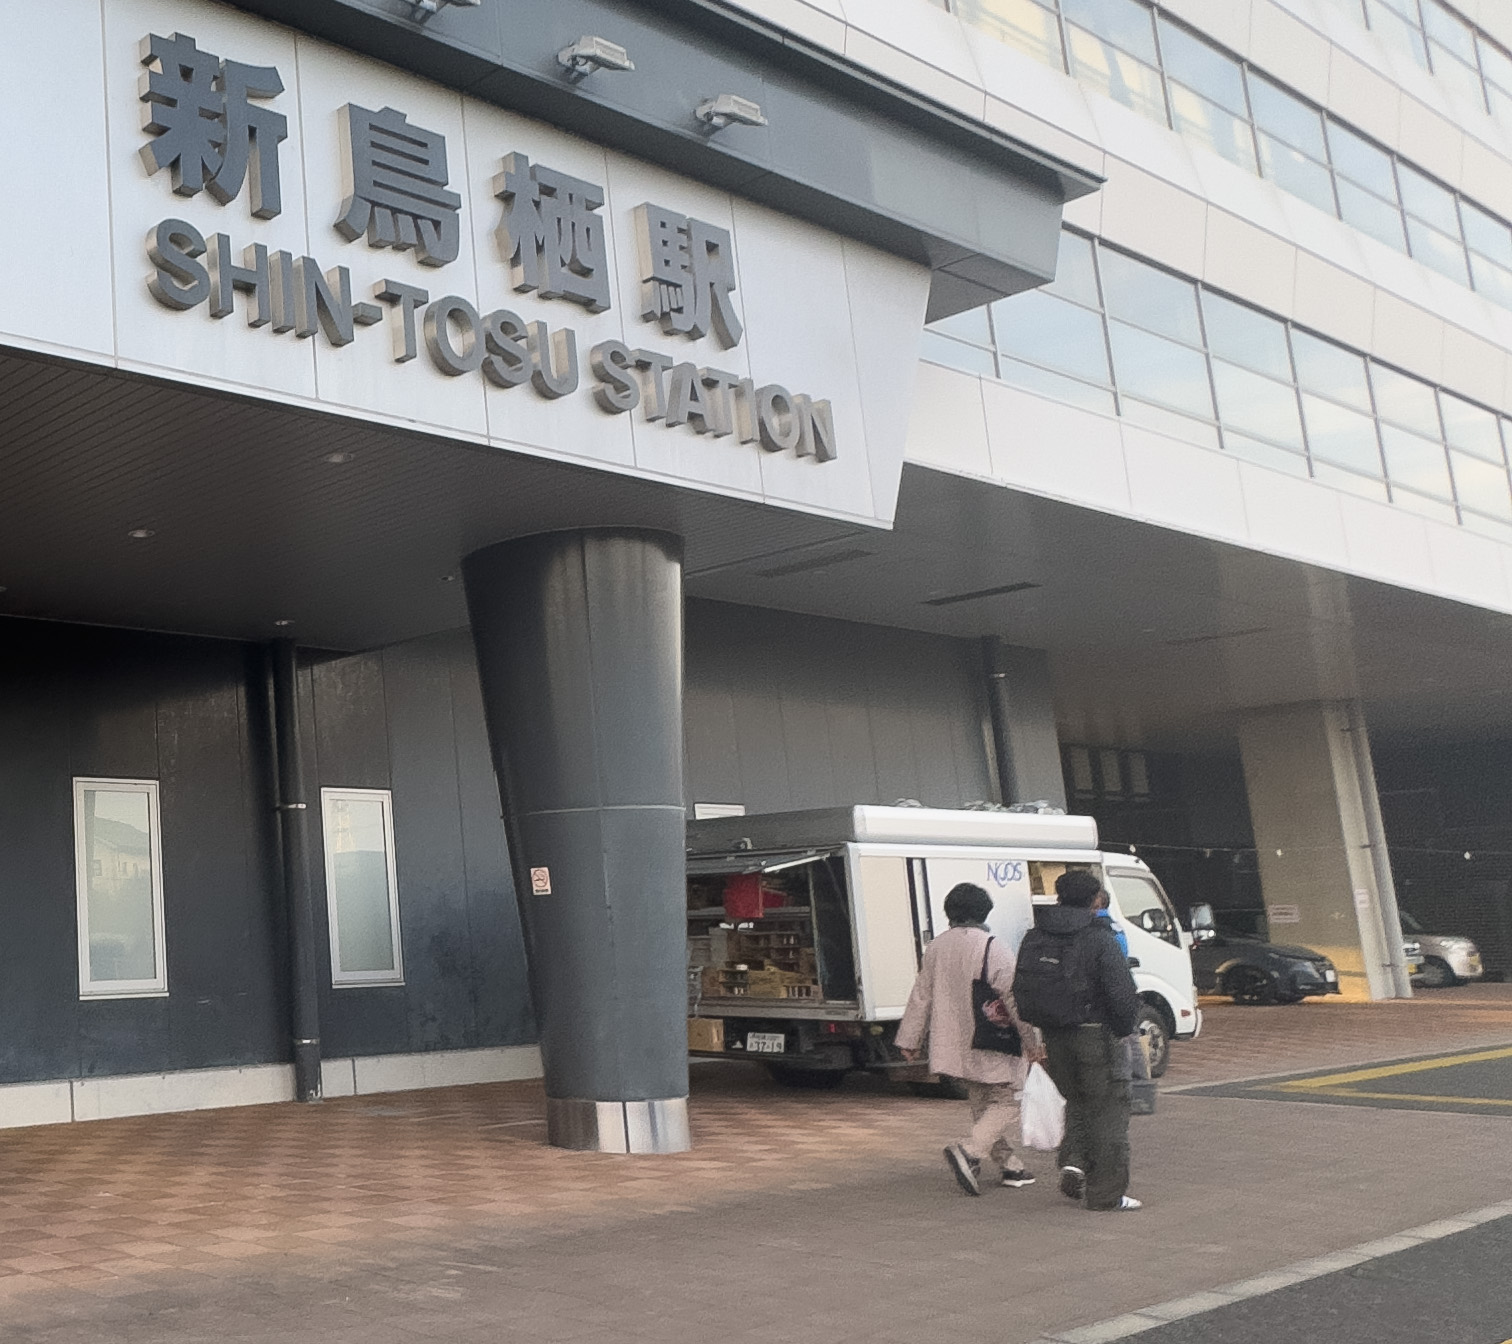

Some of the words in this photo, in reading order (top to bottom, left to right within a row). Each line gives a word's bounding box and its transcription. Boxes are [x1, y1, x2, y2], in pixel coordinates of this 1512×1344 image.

[139, 32, 743, 350] 新鳥栖駅
[146, 218, 579, 399] SHIN-TOSU
[591, 340, 837, 462] STATION
